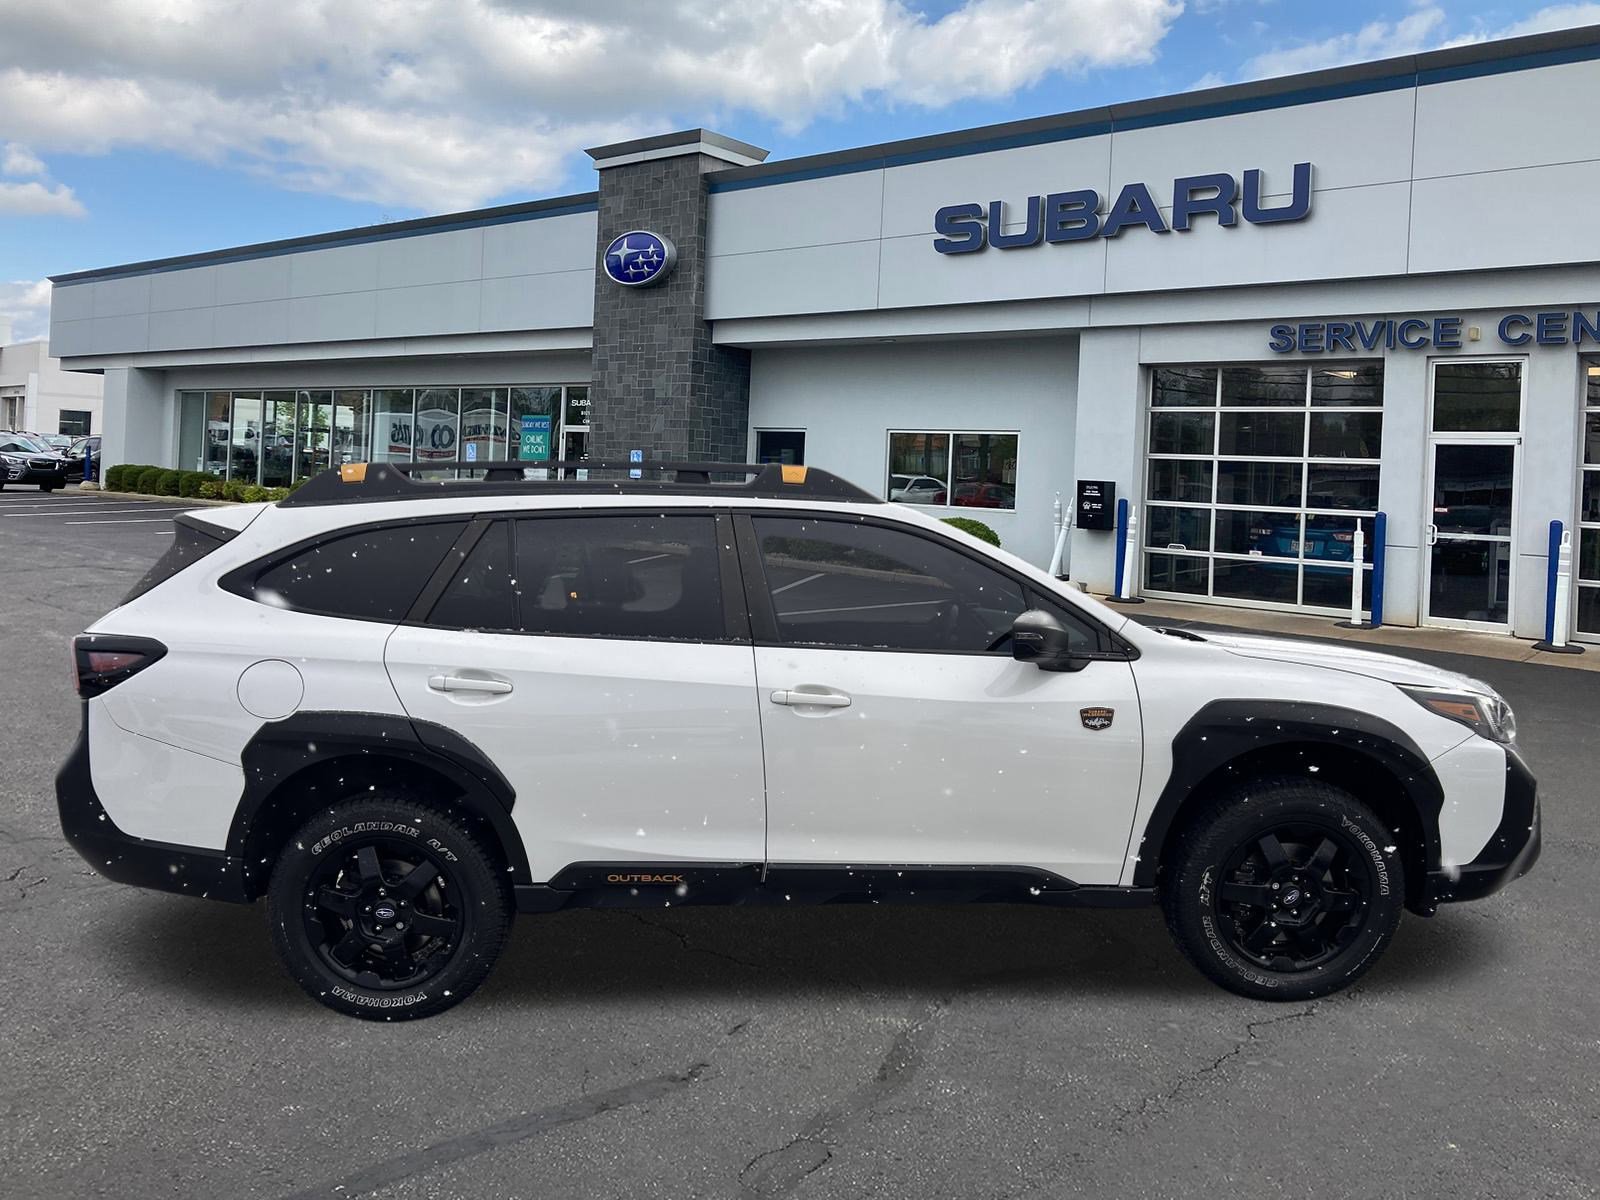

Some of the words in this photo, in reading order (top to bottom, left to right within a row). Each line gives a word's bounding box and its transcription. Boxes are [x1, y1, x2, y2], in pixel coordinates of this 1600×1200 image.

[933, 161, 1315, 256] SUBARU
[1269, 317, 1463, 353] SERVICE
[1497, 311, 1600, 346] CEN
[312, 821, 421, 855] GEOLANDAR
[427, 838, 458, 862] A/T
[1341, 814, 1390, 895] YOKOHAMA
[607, 874, 683, 882] OUTBACK
[331, 985, 428, 1008] YOKOHAMA
